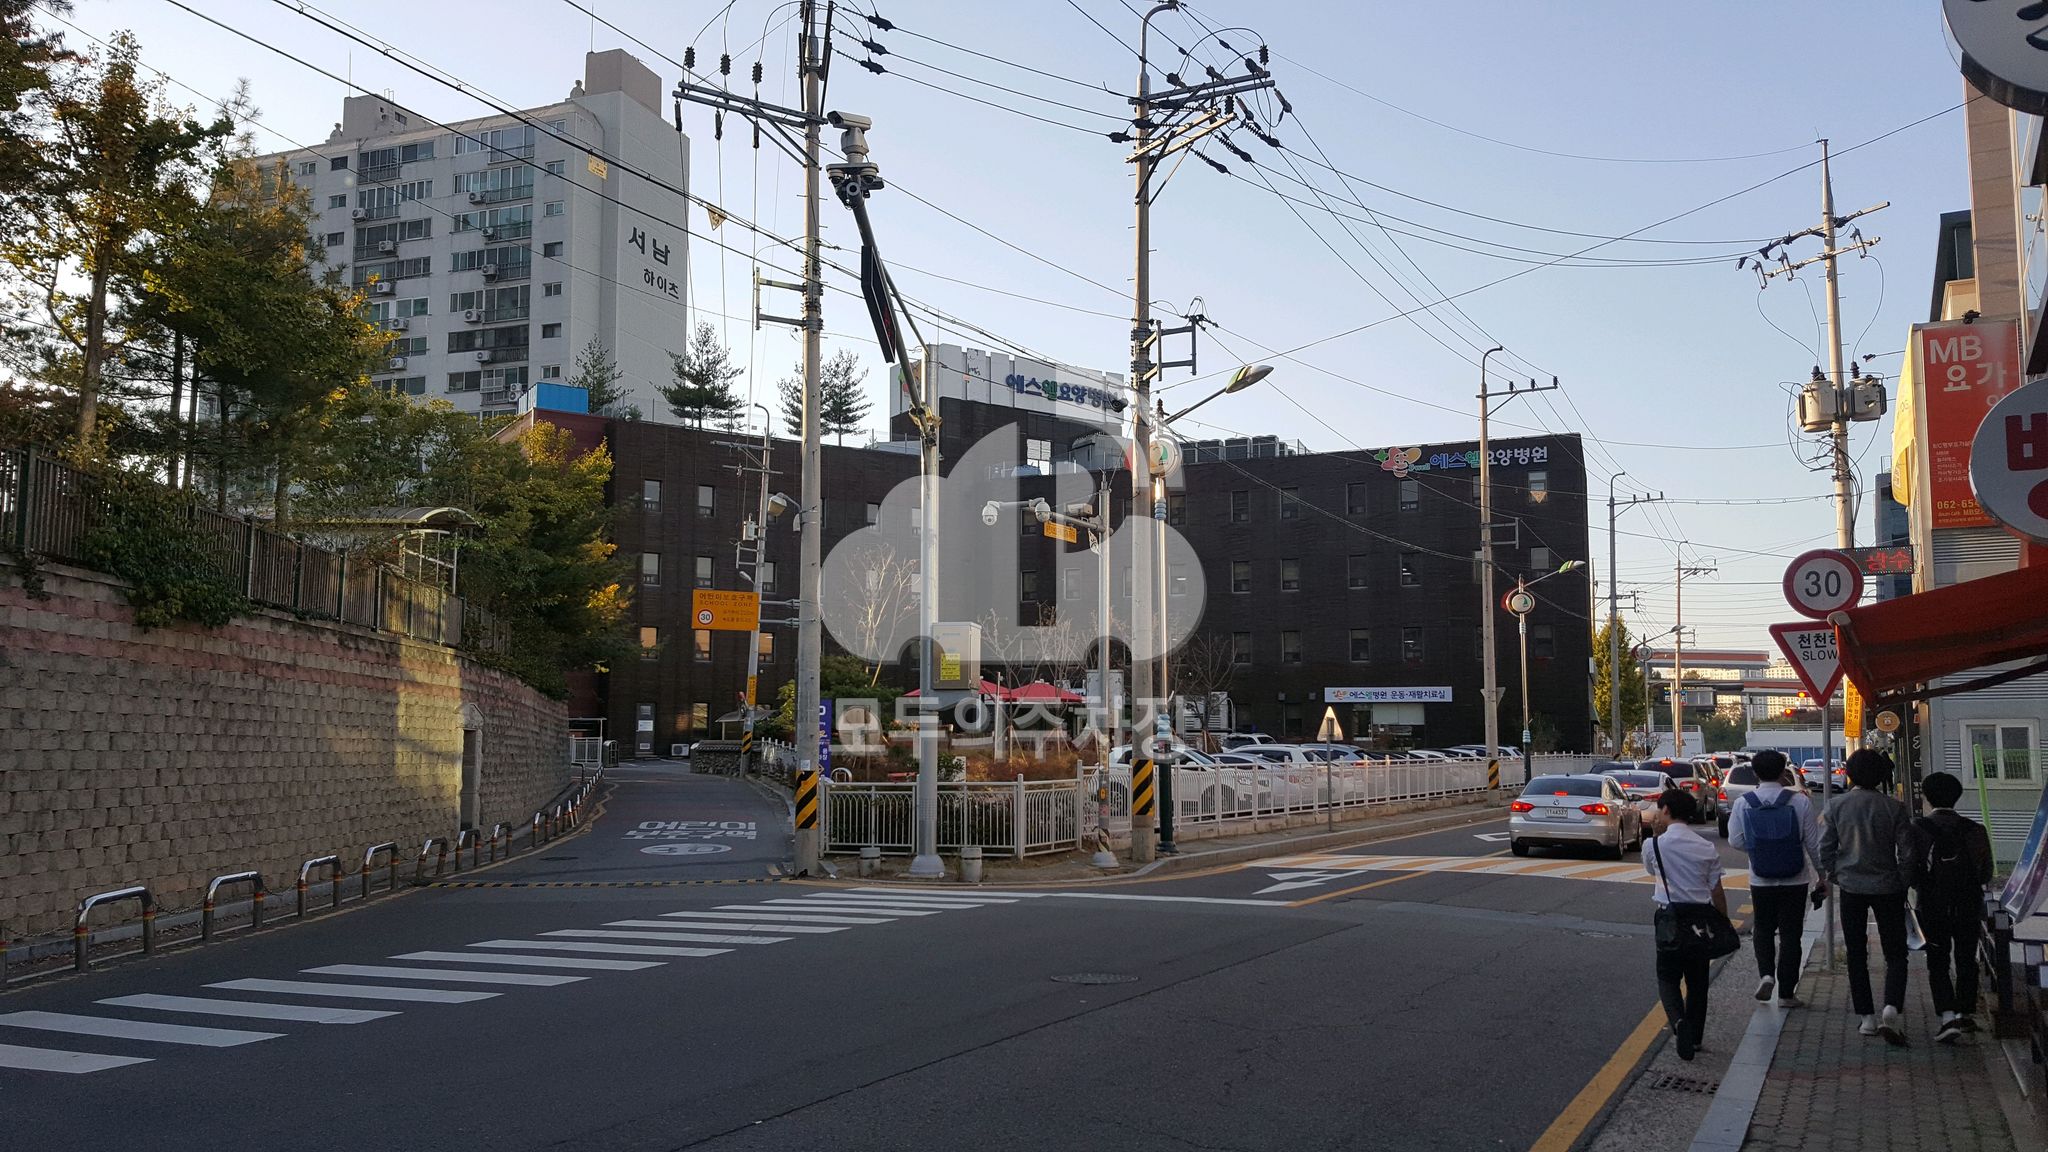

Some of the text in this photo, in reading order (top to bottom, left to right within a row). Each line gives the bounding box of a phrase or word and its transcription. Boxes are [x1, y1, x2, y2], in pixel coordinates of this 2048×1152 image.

[628, 226, 671, 266] 서남
[643, 268, 680, 300] 하이츠
[1929, 334, 1983, 365] MB
[1943, 362, 2007, 392] 요가
[1804, 569, 1842, 598] 30
[700, 613, 711, 621] 30
[1802, 649, 1838, 661] SLOW
[620, 830, 757, 840] 보호구역
[638, 821, 757, 830] 어린이
[649, 844, 722, 854] 30
